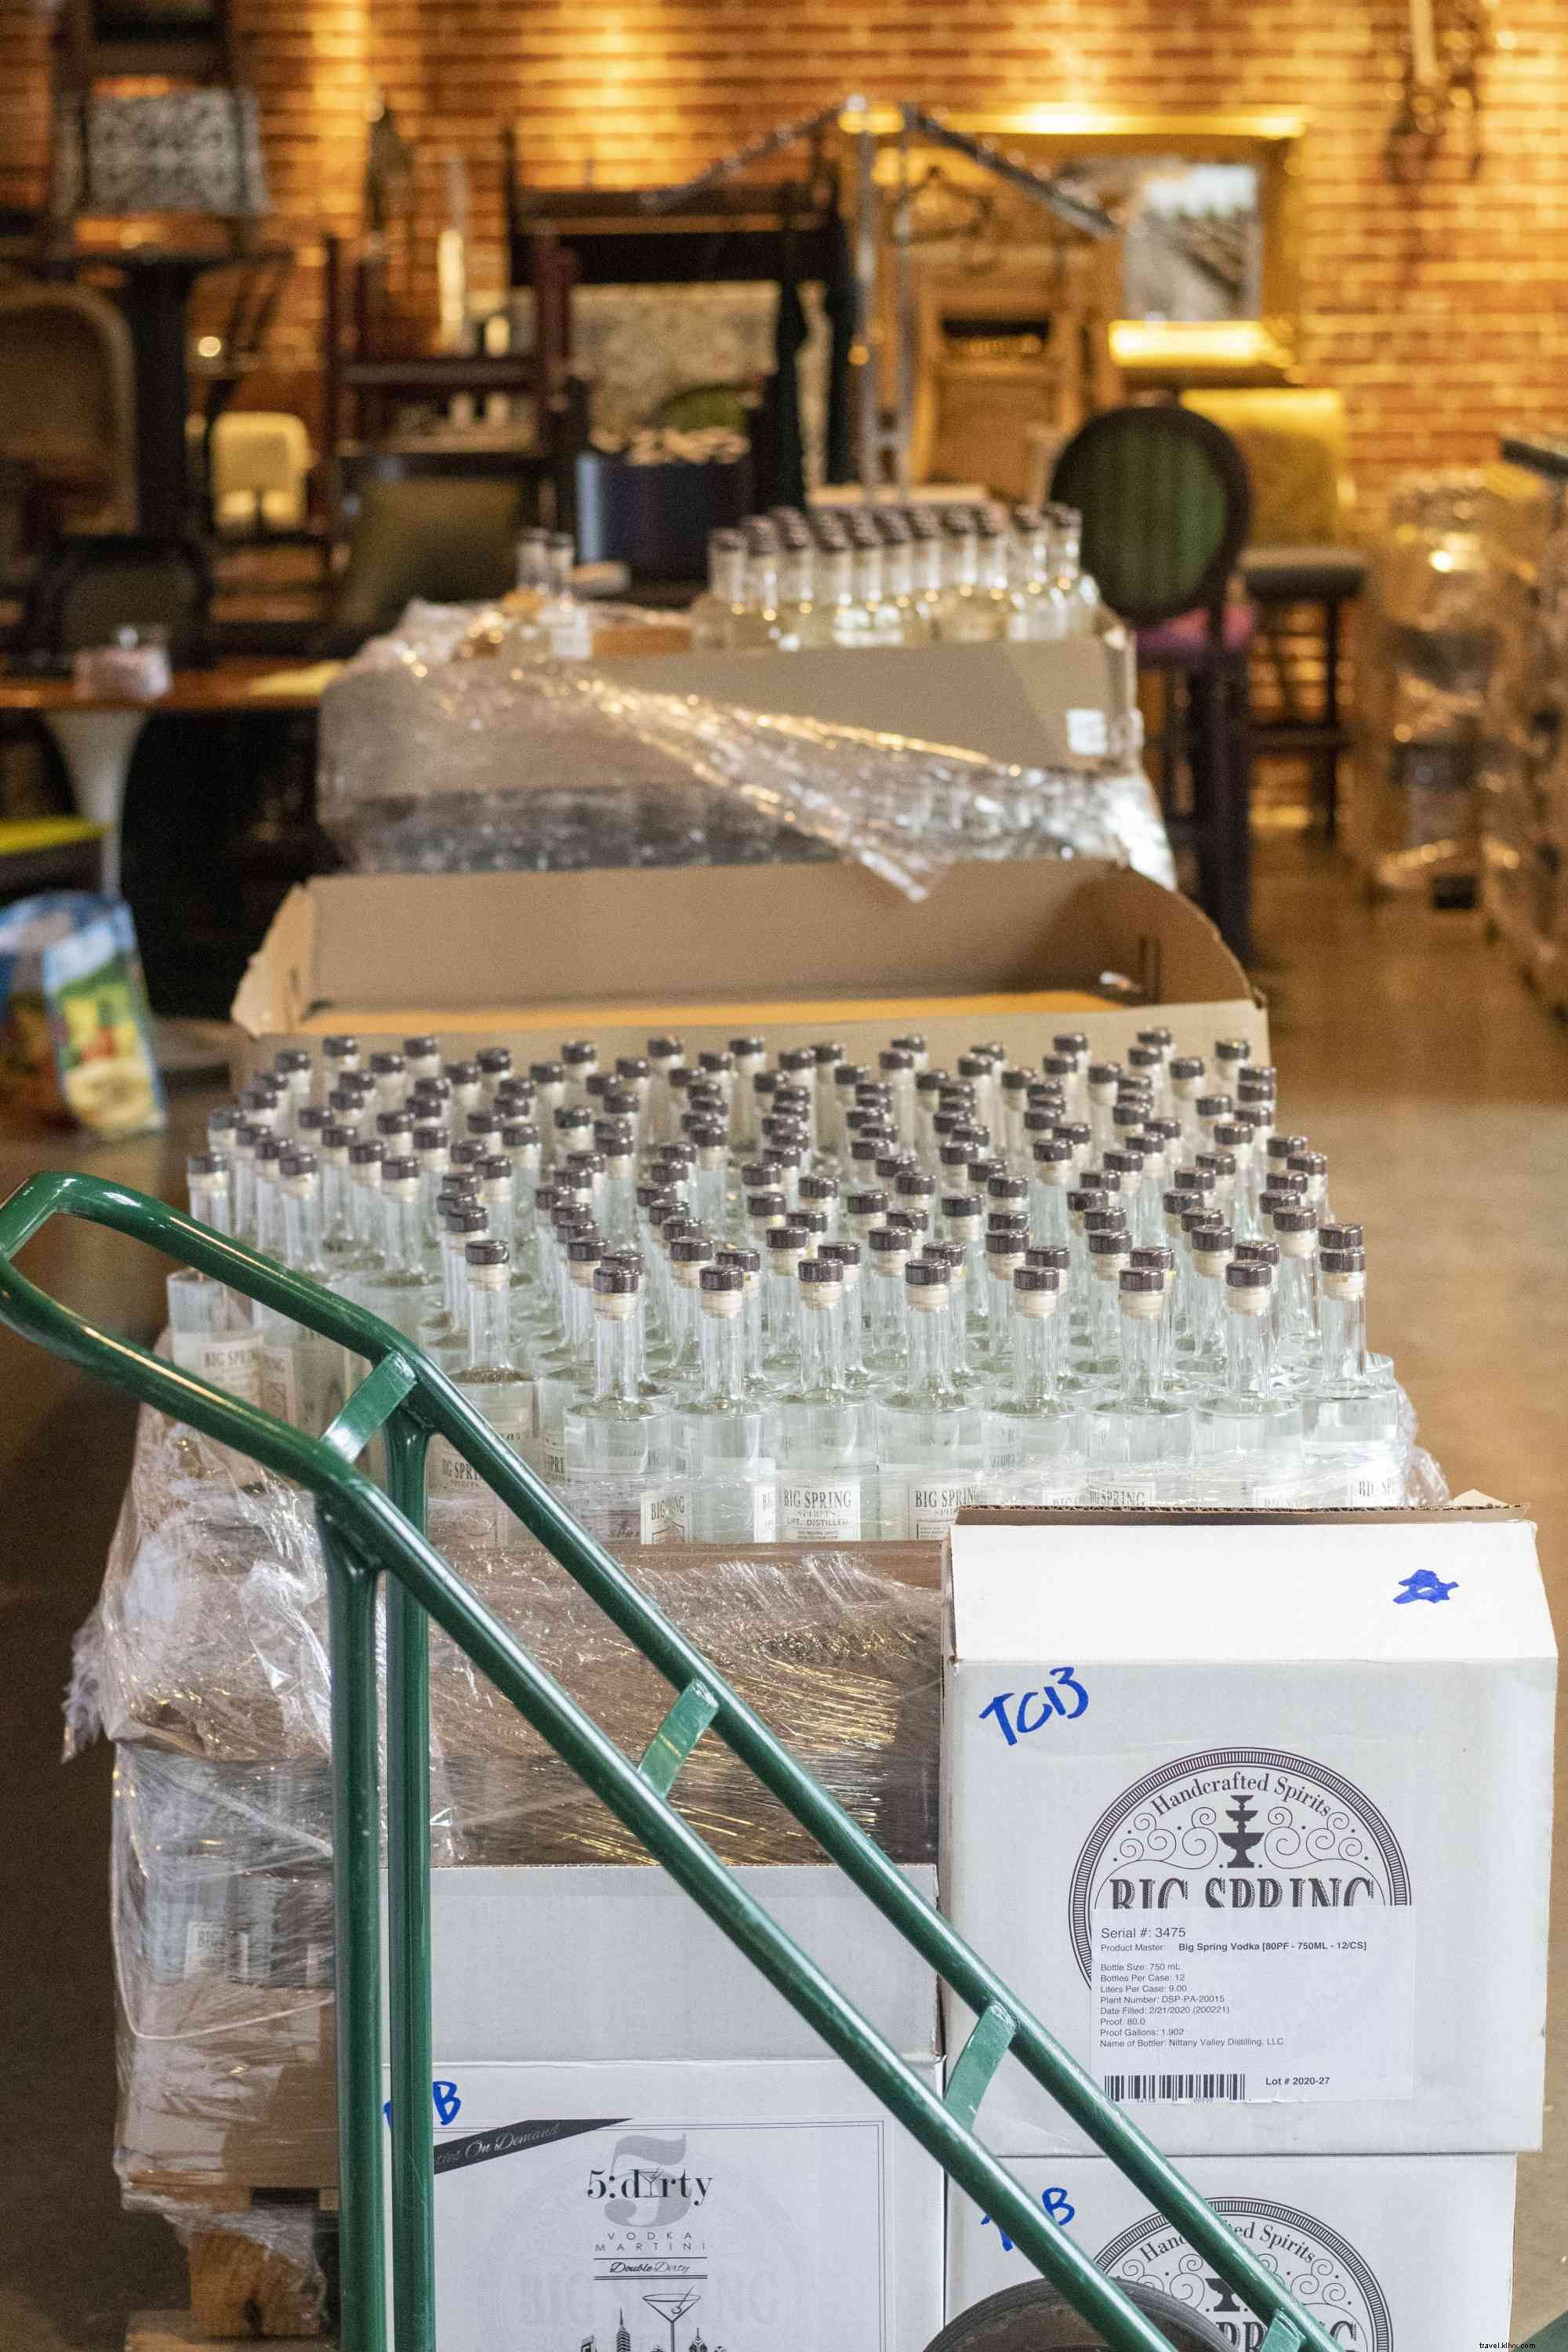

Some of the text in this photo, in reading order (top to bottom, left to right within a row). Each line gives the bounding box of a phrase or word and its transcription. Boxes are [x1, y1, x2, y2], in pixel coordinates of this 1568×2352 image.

[784, 1490, 851, 1508] BIG SPRING
[916, 1490, 938, 1508] BIG
[1150, 1770, 1331, 1817] Handcrafted Spirits
[1100, 1927, 1136, 1939] Serial
[1154, 1926, 1187, 1939] 3475
[1100, 1943, 1133, 1951] Product
[1178, 1943, 1195, 1953] Big
[1196, 1943, 1228, 1953] Spring
[1230, 1941, 1260, 1951] Vodka
[1261, 1940, 1290, 1952] [80PF
[1298, 1941, 1328, 1951] 750ML
[1337, 1940, 1367, 1951] 12/CS]
[1100, 1962, 1124, 1971] Bottle
[1126, 1962, 1147, 1971] Size:
[1149, 1962, 1166, 1971] 750
[1100, 1973, 1185, 1983] Bottles Per Case: 12
[1100, 1984, 1188, 1994] Liters Per Case: 9.00
[1100, 1994, 1225, 2004] Plant Number: DSP-PA-20015
[1100, 2005, 1230, 2015] Date Filled: 2/21/2020 (200221)
[1099, 2017, 1145, 2026] Proof: 80.0
[1099, 2027, 1185, 2037] Proof Gallons: 1.902
[1099, 2039, 1124, 2048] Name
[1127, 2038, 1135, 2047] of
[1137, 2038, 1166, 2047] Bottler:
[1168, 2038, 1198, 2048] Nittany
[1200, 2038, 1225, 2048] Valley
[1266, 2038, 1284, 2046] LLC
[1265, 2076, 1330, 2085] Lot # 2020-27
[466, 2140, 490, 2158] On
[494, 2122, 560, 2151] Demand
[608, 2232, 692, 2241] VODKA
[595, 2242, 706, 2252] MARTINI
[1259, 2223, 1316, 2263] Spirits
[609, 2261, 691, 2274] Double Dirty
